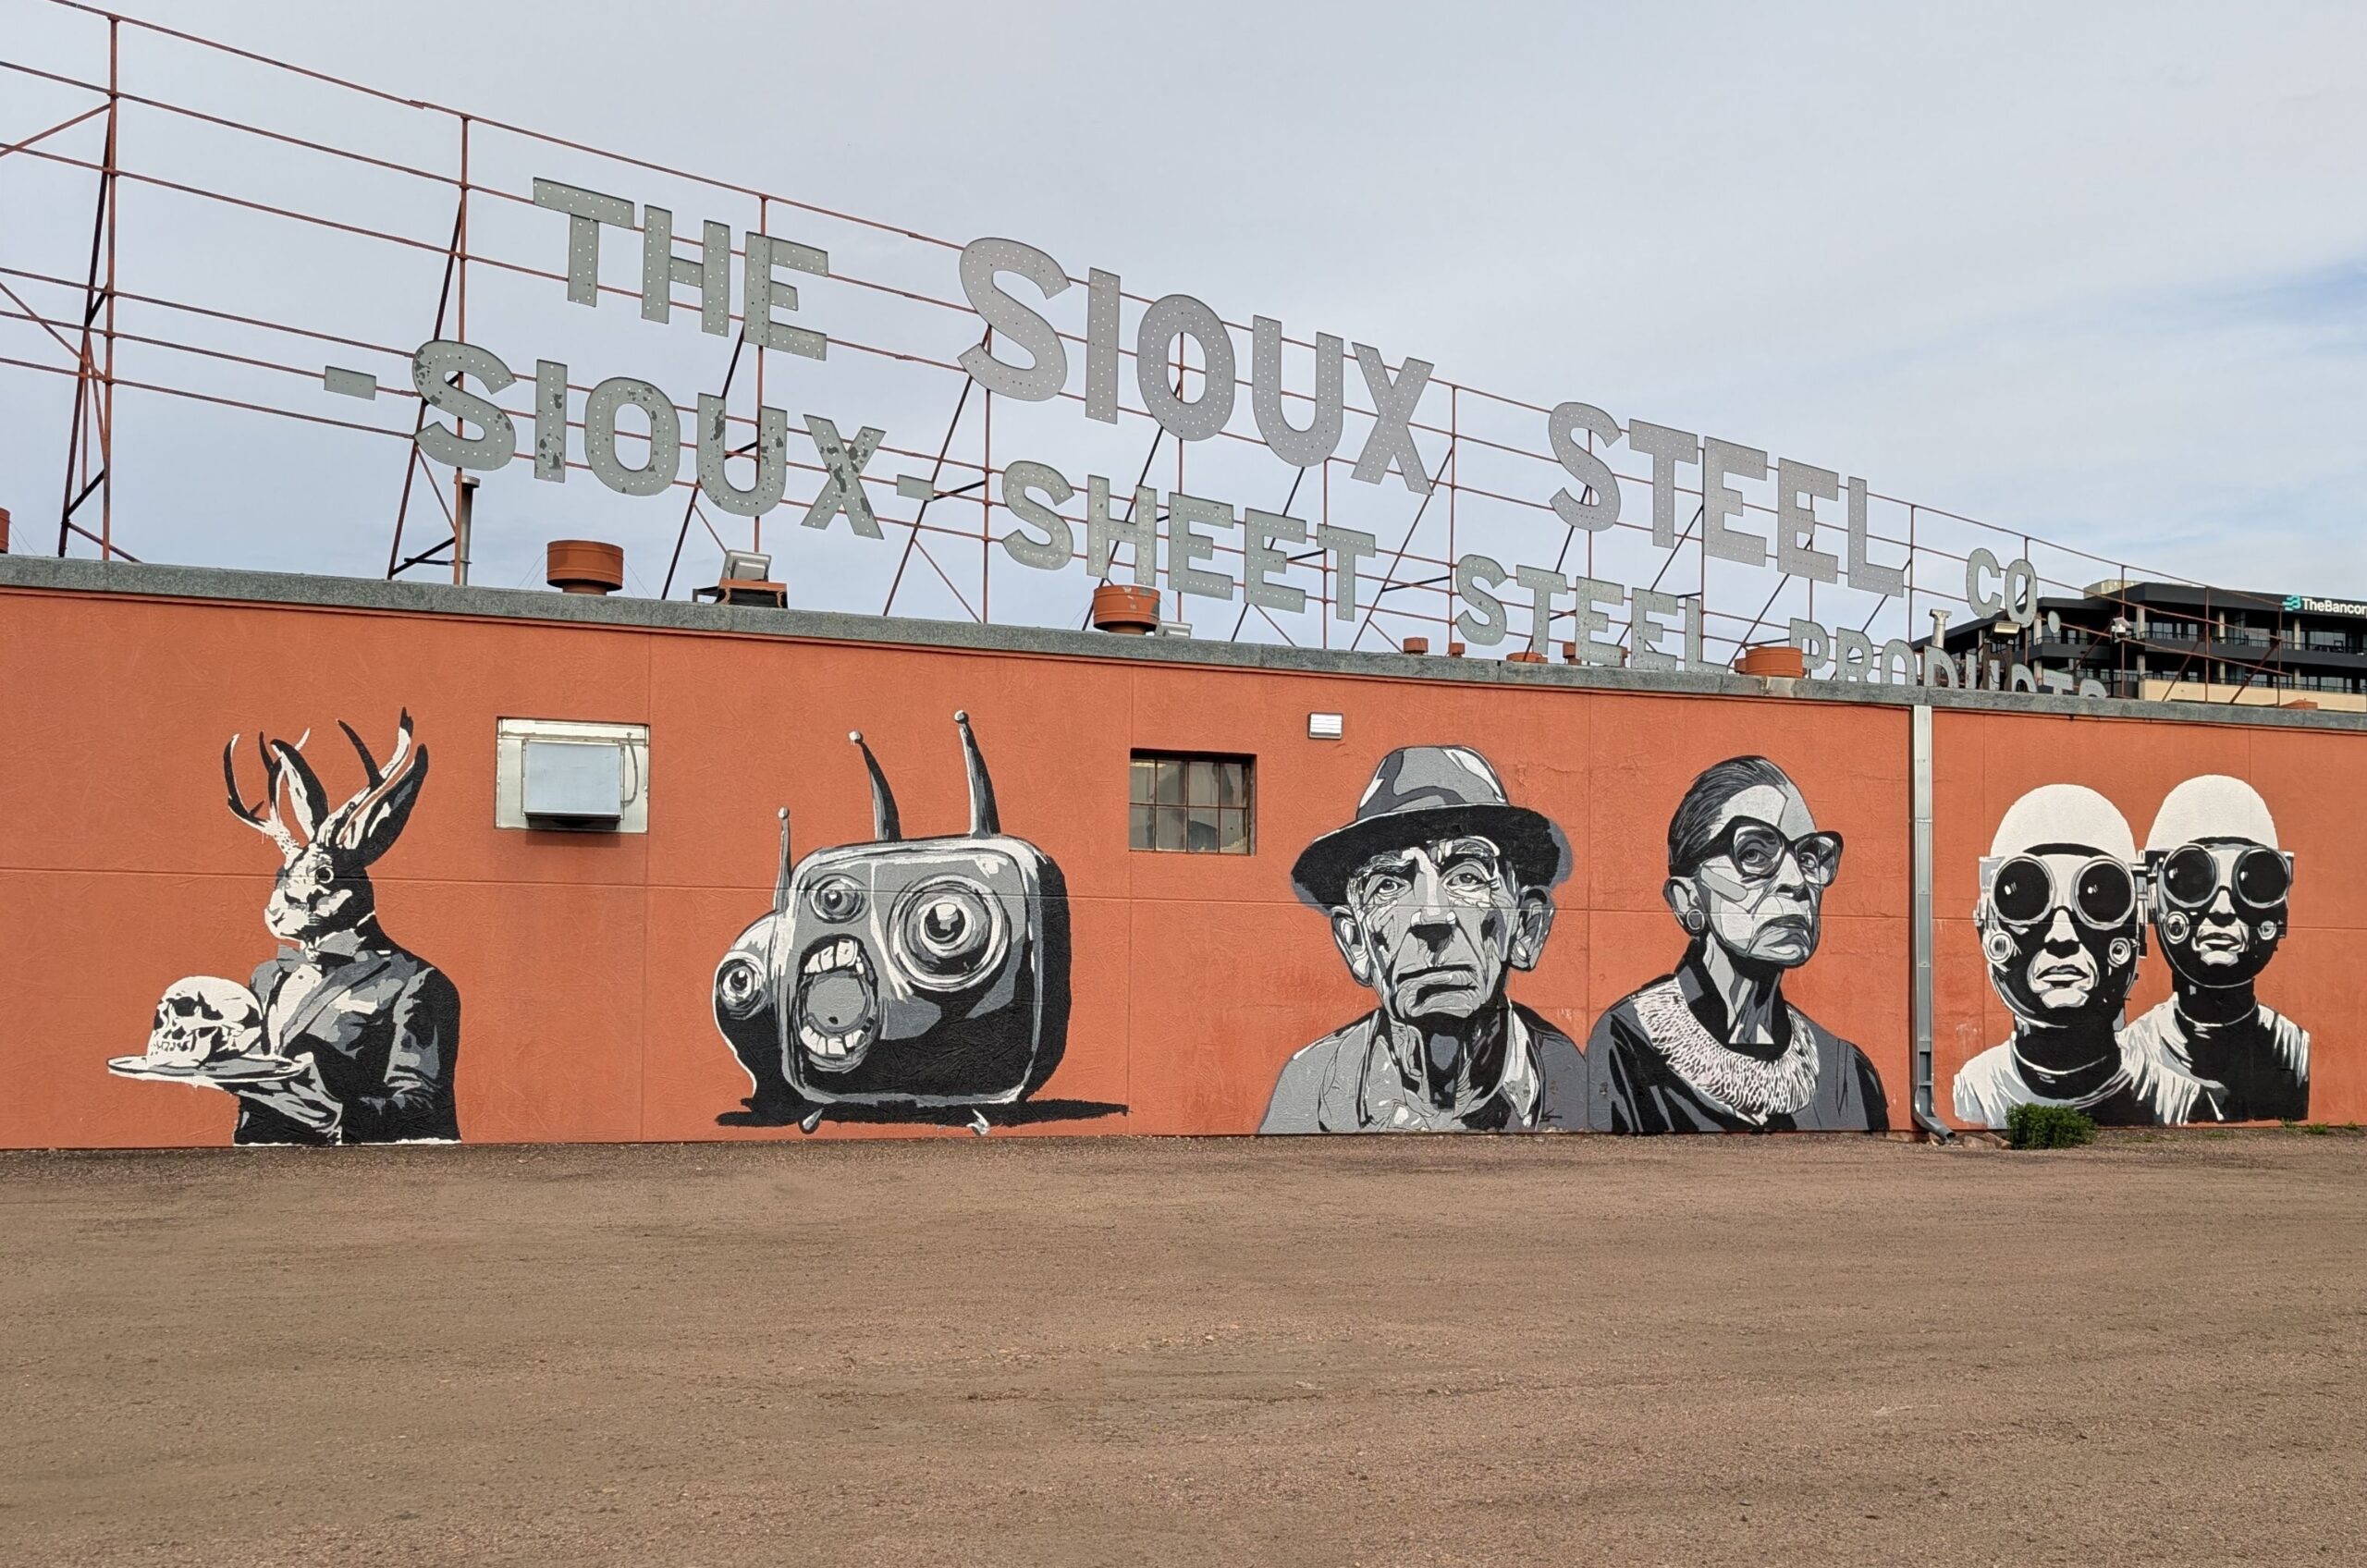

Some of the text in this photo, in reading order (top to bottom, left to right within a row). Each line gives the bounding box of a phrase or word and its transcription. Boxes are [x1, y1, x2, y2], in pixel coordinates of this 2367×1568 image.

[533, 177, 828, 361] THE
[957, 237, 1435, 496] SIOUX
[1548, 401, 1905, 598] STEEL
[1001, 459, 1376, 622] SHEET
[1454, 554, 1728, 675] STEEL
[2301, 597, 2367, 619] TheBancor
